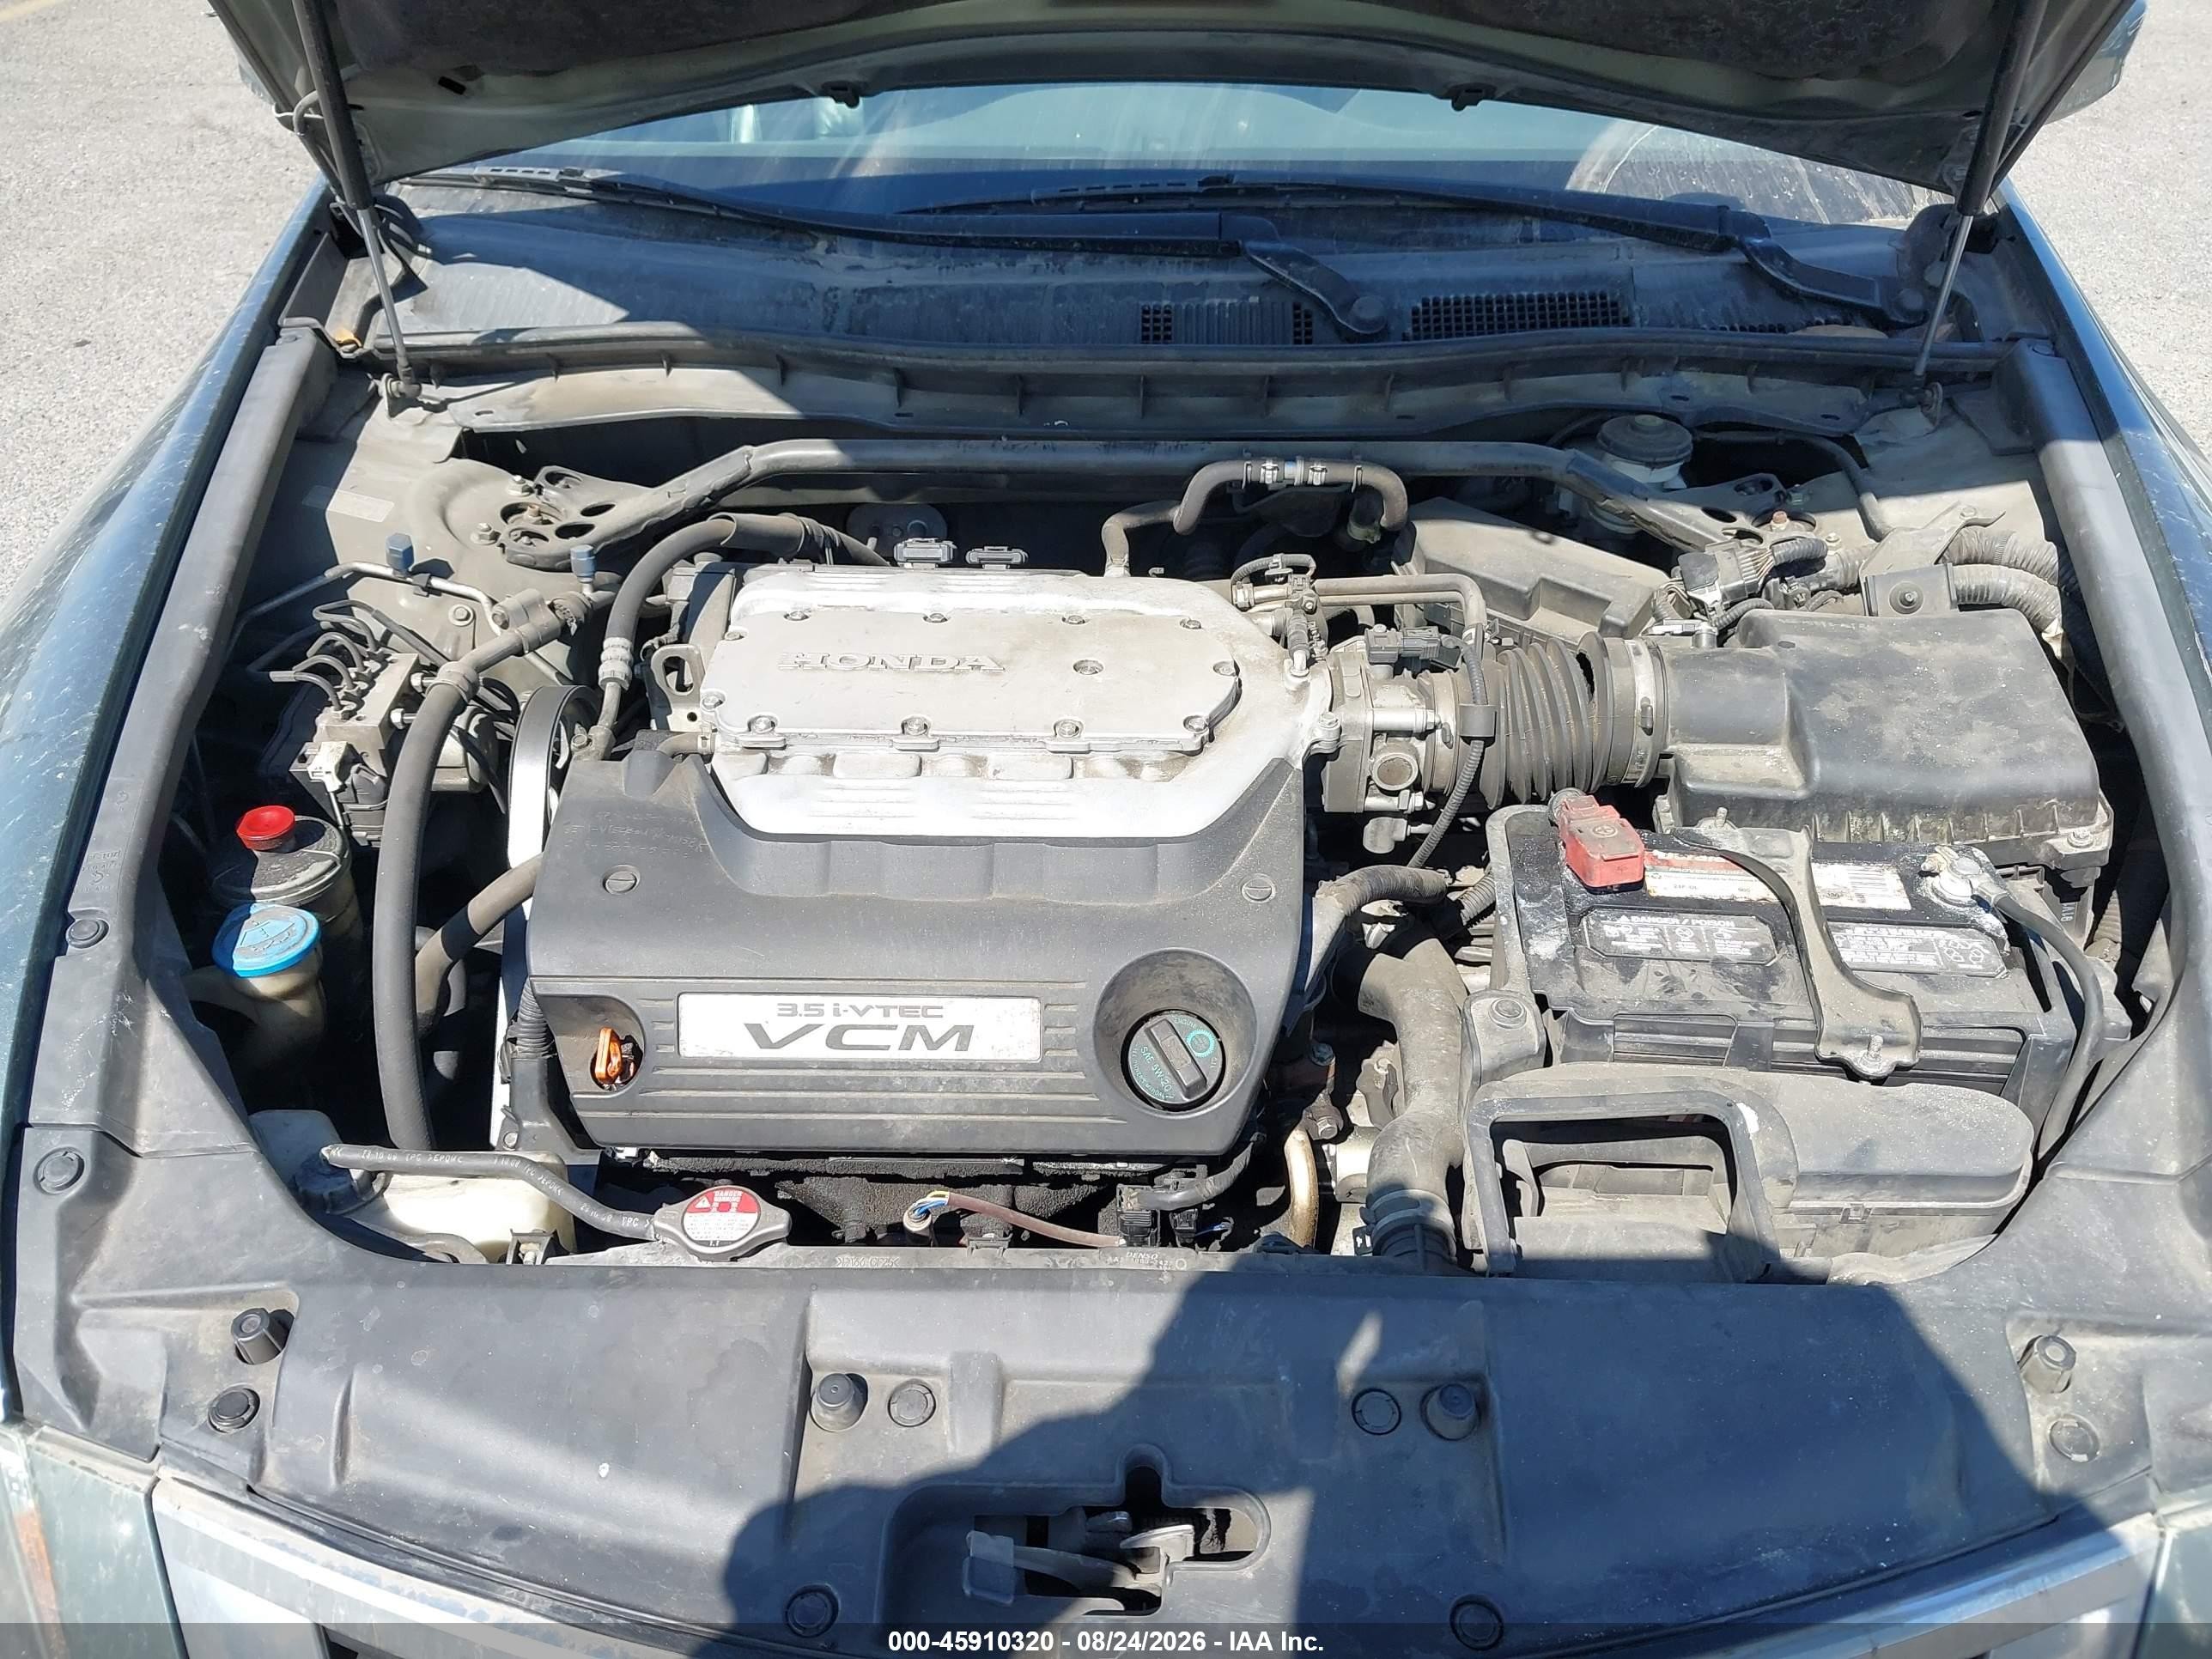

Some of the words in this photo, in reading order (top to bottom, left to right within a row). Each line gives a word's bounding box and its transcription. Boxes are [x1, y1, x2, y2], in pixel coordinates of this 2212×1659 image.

[778, 653, 1006, 672] HONDA
[1632, 915, 1680, 925] DANGER
[1691, 919, 1735, 927] POISON
[776, 1003, 824, 1018] 3.5
[833, 1003, 944, 1018] i-VTEC
[744, 1023, 975, 1052] VCM
[1140, 1046, 1155, 1064] SAE
[1152, 1064, 1172, 1092] 5W-20
